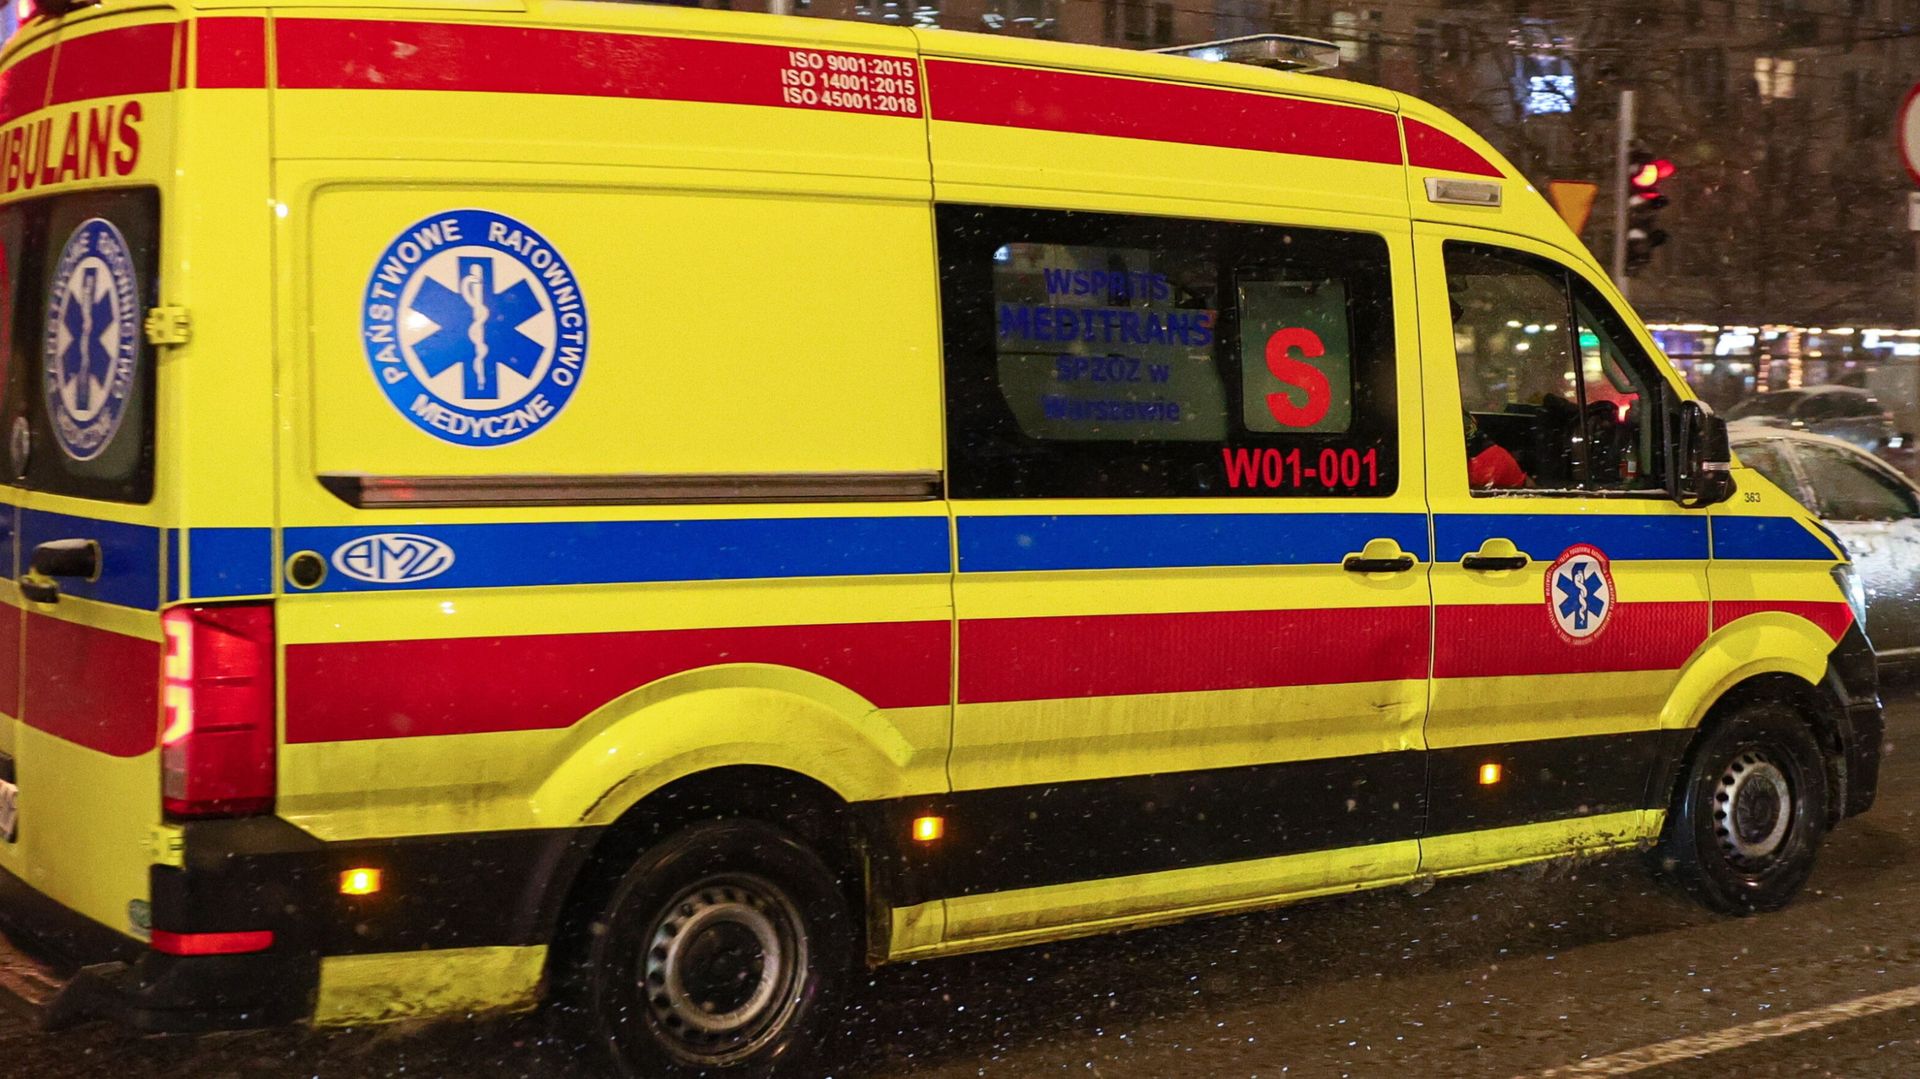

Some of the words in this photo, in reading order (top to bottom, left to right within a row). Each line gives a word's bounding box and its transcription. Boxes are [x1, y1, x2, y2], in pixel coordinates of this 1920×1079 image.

[781, 69, 816, 87] ISO
[820, 72, 916, 95] 14001:2015
[789, 51, 824, 69] ISO
[826, 54, 913, 77] 9001:2015
[783, 86, 819, 105] ISO
[821, 90, 917, 113] 45001:2018
[366, 219, 463, 384] PAŃSTWOWE
[488, 221, 584, 387] RATOWNICTWO
[1000, 304, 1214, 347] MEDITRANS
[1265, 326, 1332, 428] S
[409, 393, 555, 438] MEDYCZNE
[1222, 447, 1378, 488] W01-001
